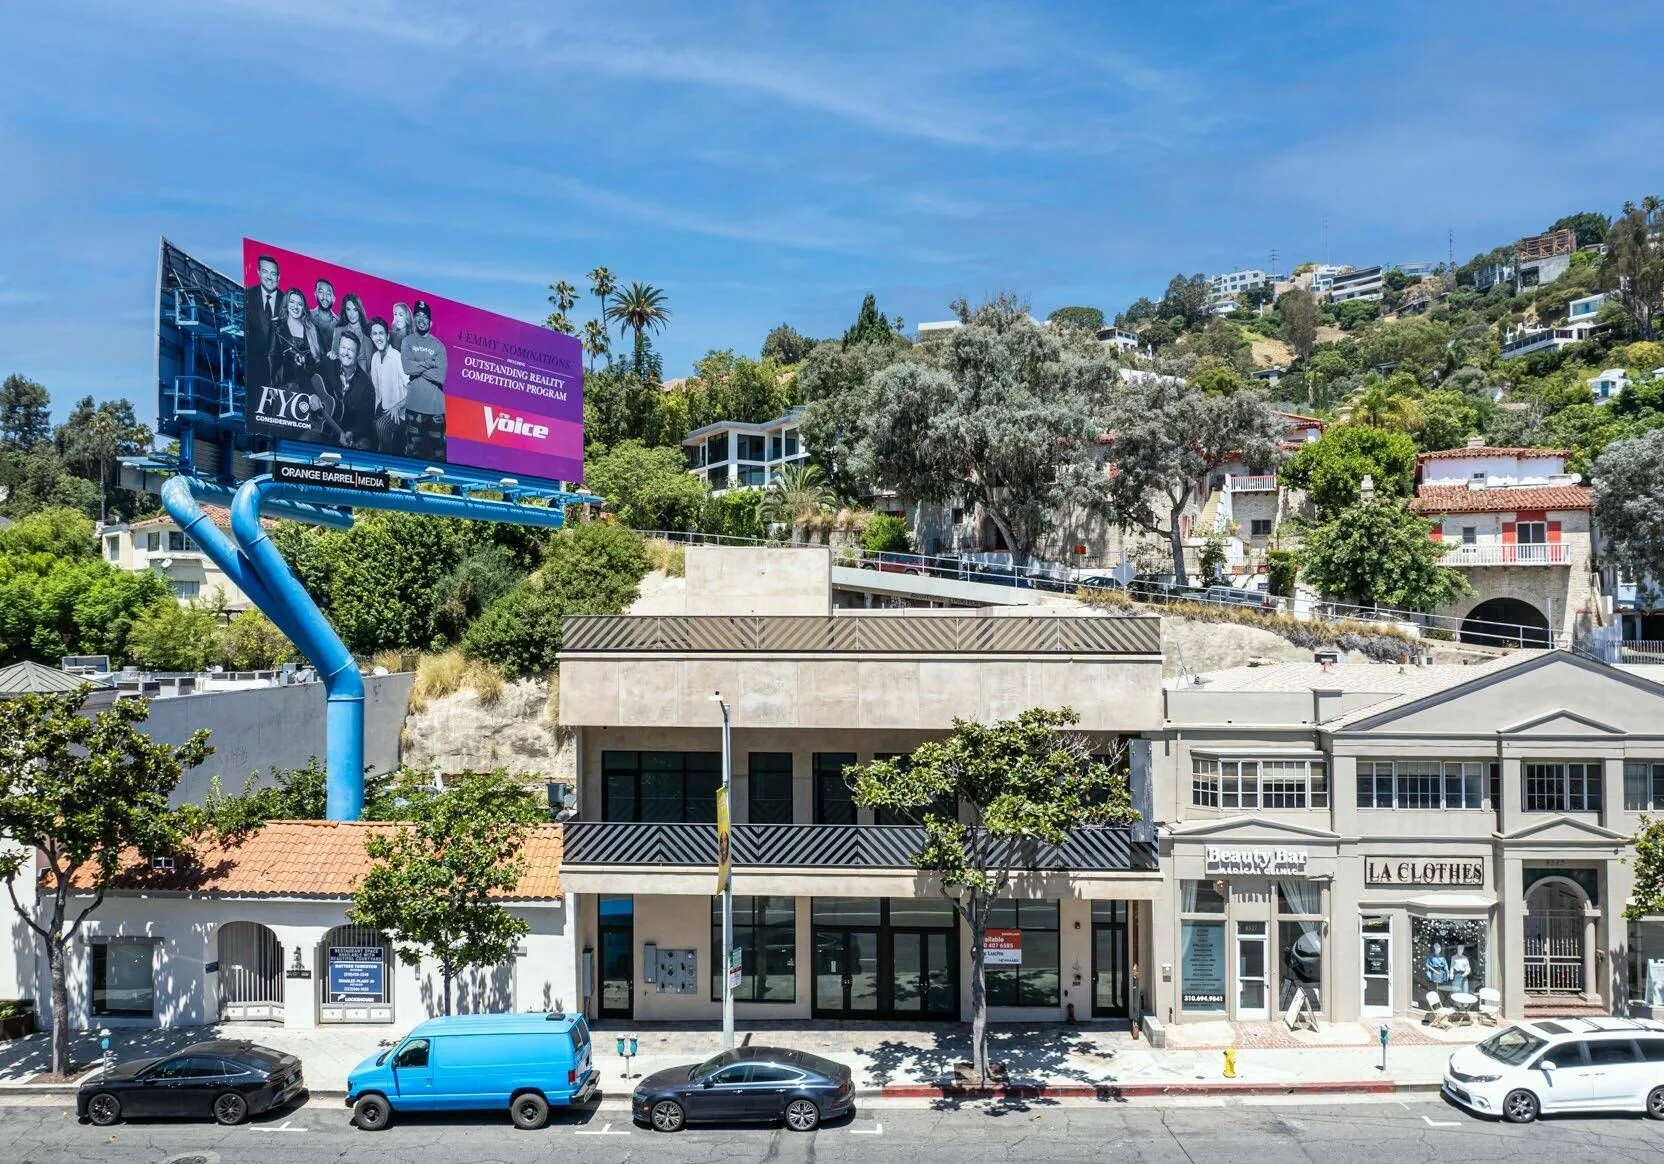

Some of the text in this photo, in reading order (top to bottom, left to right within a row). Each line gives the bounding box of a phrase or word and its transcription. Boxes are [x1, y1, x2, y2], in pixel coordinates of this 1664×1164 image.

[457, 331, 571, 370] 4 EMMY NOMINATIONS
[462, 369, 567, 401] COMPETITION PROGRAM
[464, 356, 565, 389] OUTSTANDING REALITY
[255, 386, 312, 421] FYC
[255, 415, 312, 430] CONSIDERWB.COM
[484, 406, 549, 439] Voice
[281, 467, 385, 487] ORANGE BARREL MEDIA
[1207, 847, 1307, 867] Beauty Bar
[1369, 862, 1482, 883] LA CLOTHES
